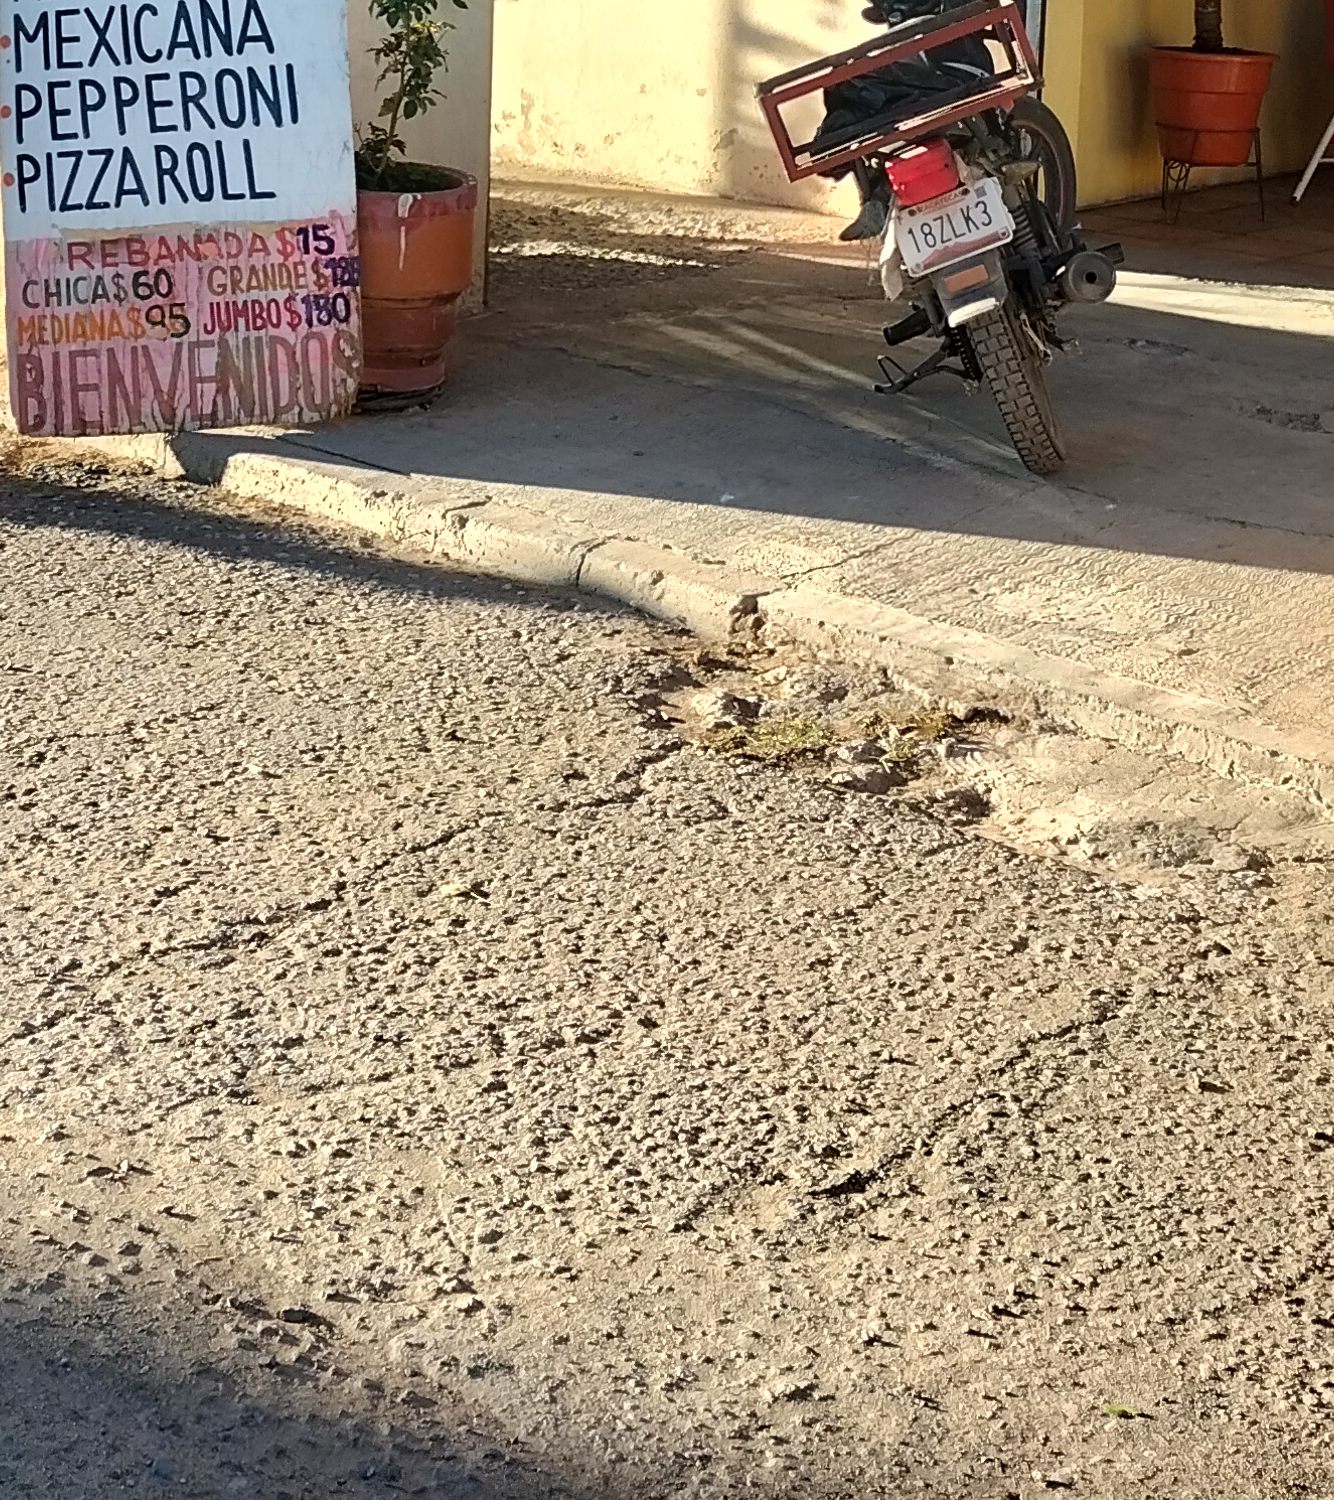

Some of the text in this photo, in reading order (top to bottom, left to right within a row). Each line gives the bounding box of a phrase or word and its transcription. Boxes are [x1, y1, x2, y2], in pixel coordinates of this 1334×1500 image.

[14, 62, 300, 145] PEPPERONI
[274, 223, 336, 262] $15
[907, 200, 993, 254] 18ZLK3
[21, 267, 174, 309] CHICA $60
[206, 260, 309, 296] GRANDE
[17, 302, 191, 347] MEDIANA $95
[203, 297, 282, 335] JUMBO
